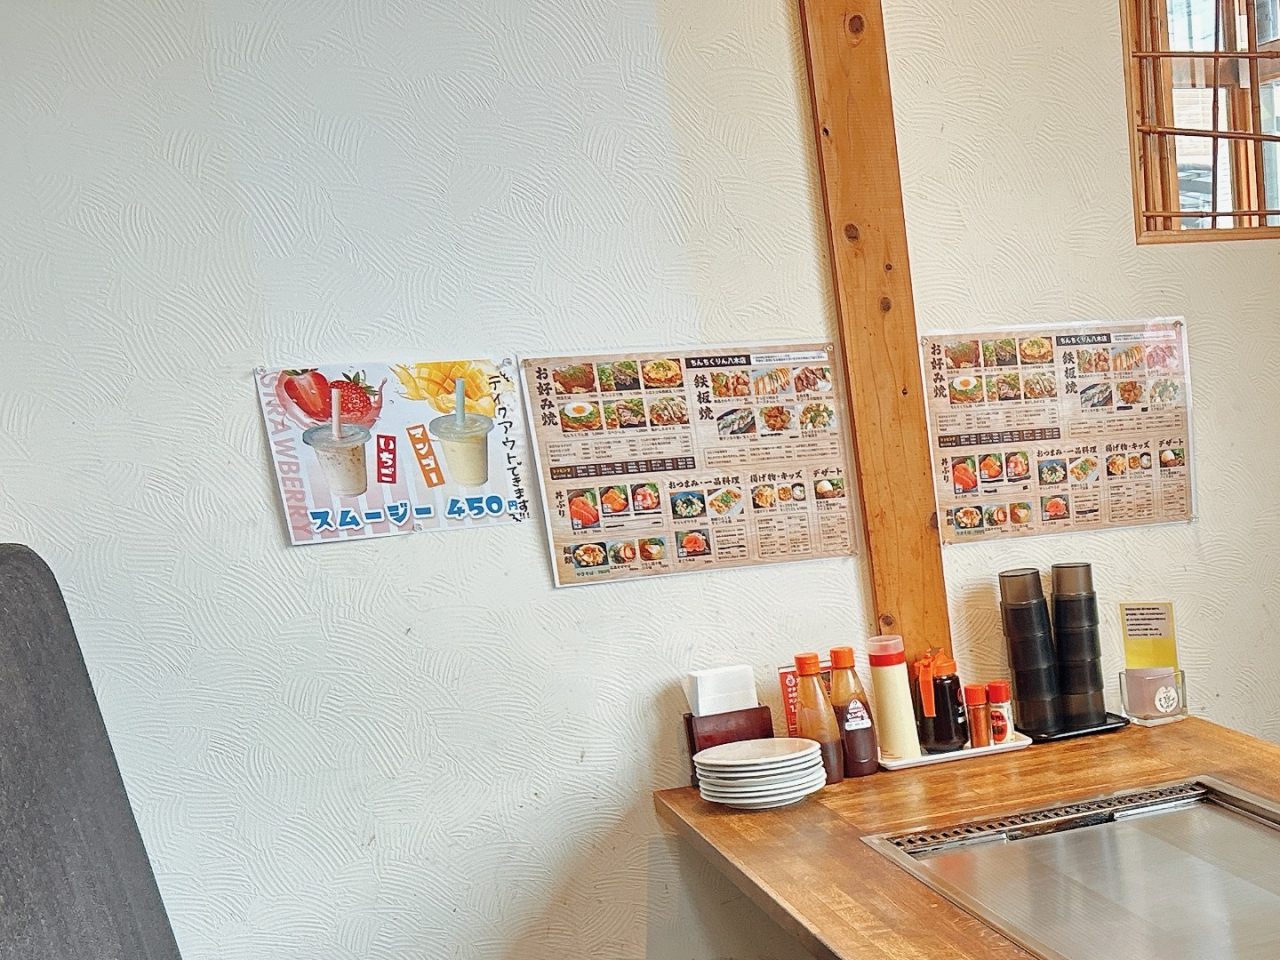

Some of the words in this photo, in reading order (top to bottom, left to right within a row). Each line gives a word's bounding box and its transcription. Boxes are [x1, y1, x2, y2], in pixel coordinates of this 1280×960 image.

[930, 343, 948, 399] お好み焼
[1062, 351, 1078, 395] 鉄板焼
[535, 366, 559, 427] お好み焼
[693, 373, 715, 421] 鉄板焼
[379, 437, 395, 482] いちご
[408, 427, 439, 485] マンゴー
[812, 467, 843, 478] デザート
[309, 502, 432, 531] スムージー
